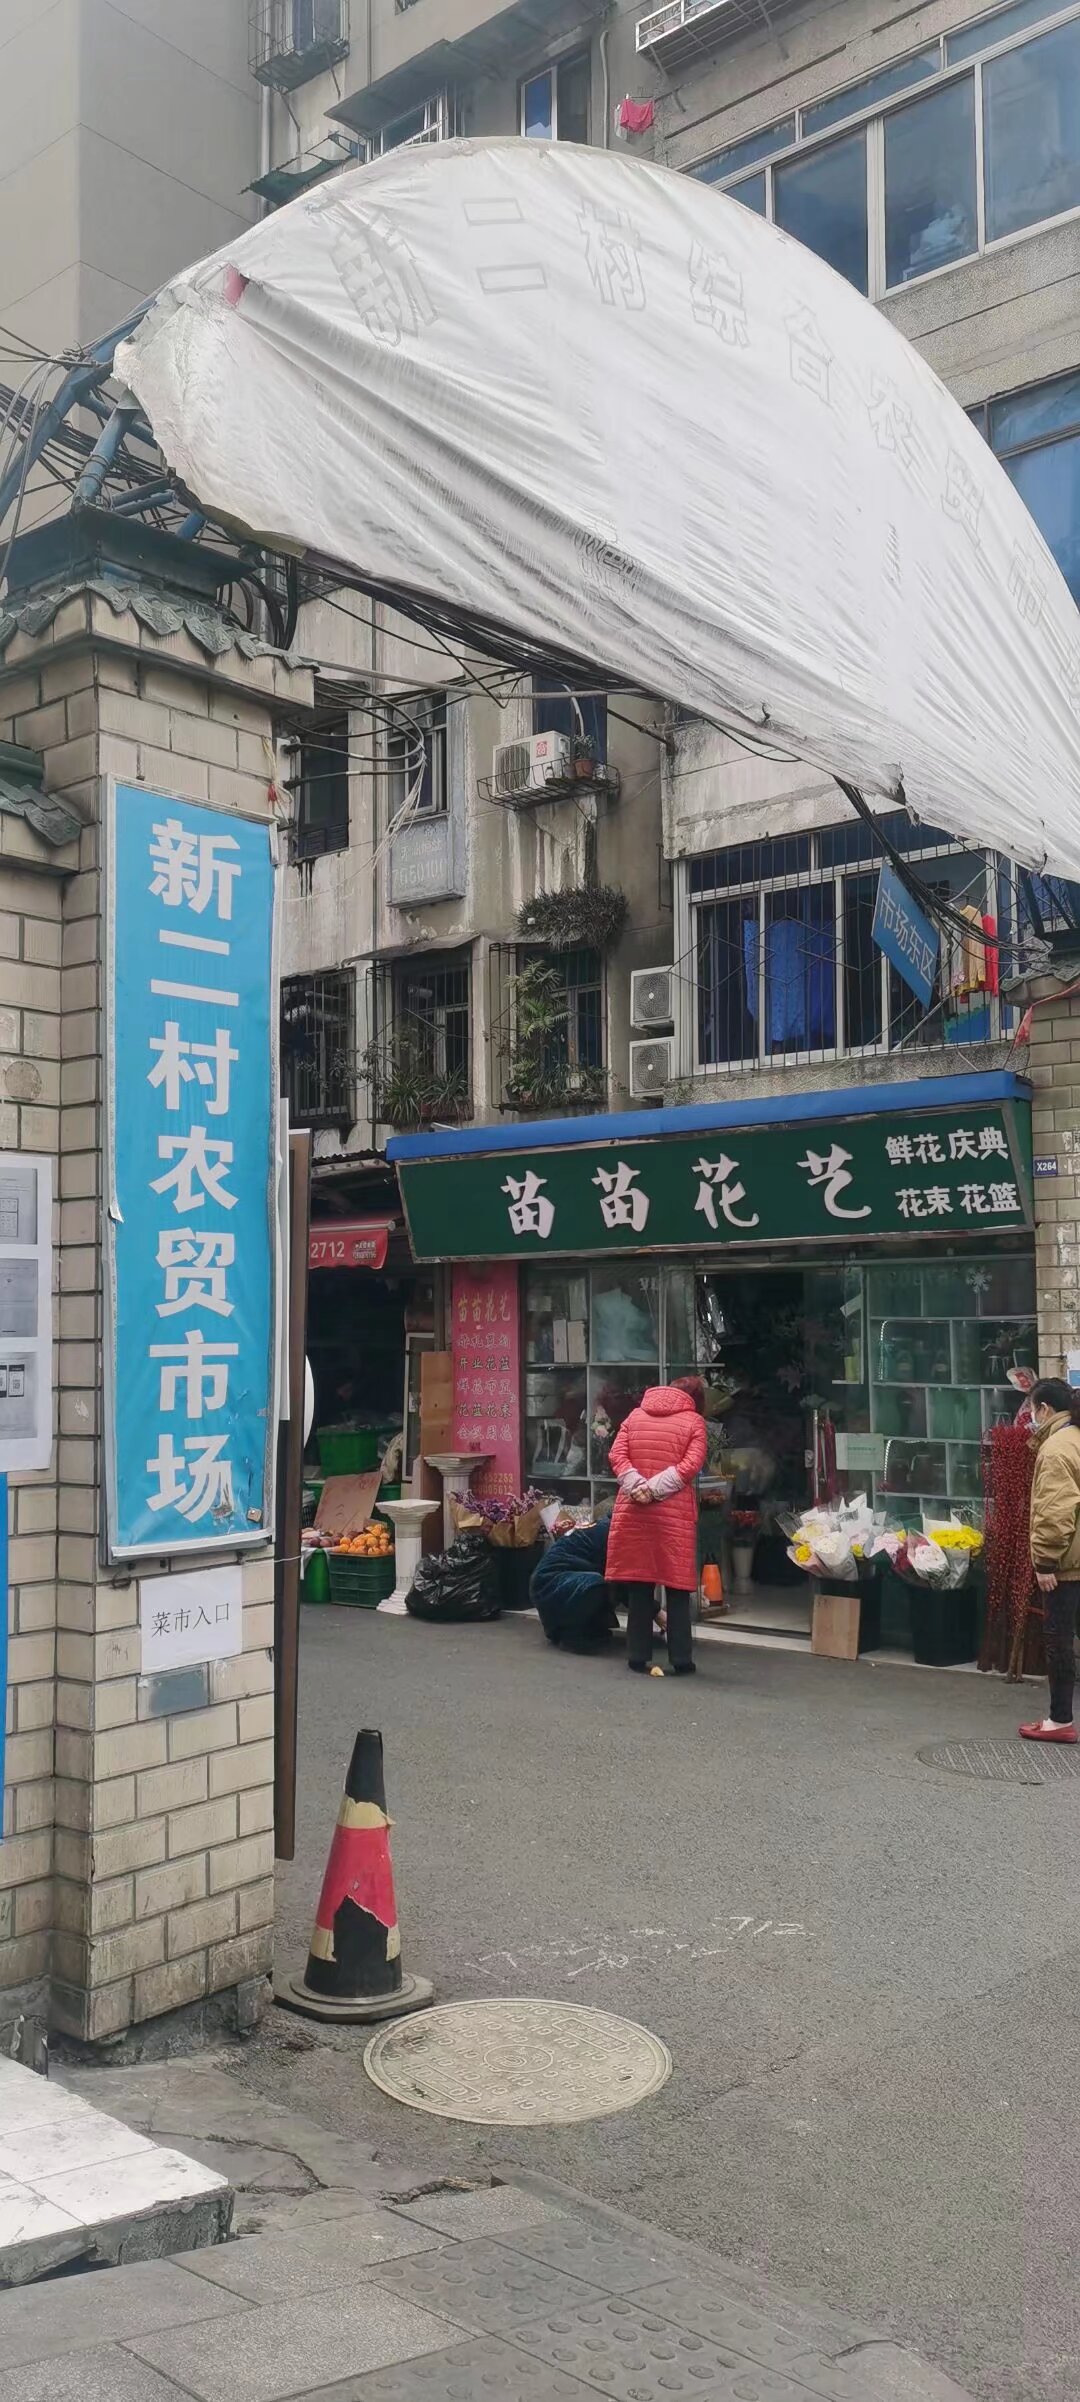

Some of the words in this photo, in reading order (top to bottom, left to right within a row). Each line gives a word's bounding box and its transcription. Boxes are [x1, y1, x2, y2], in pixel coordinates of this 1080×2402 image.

[878, 887, 936, 986] 市场东区
[885, 1133, 946, 1165] 鲜花
[948, 1127, 1009, 1160] 庆典
[146, 818, 242, 1524] 新二村农贸市场
[1036, 1161, 1057, 1172] X264
[500, 1143, 873, 1239] 苗苗花艺
[895, 1186, 954, 1218] 花束
[957, 1182, 1021, 1214] 花篮
[310, 1241, 345, 1259] 2712
[457, 1289, 511, 1323] 苗苗花艺
[151, 1603, 230, 1638] 菜市入口
